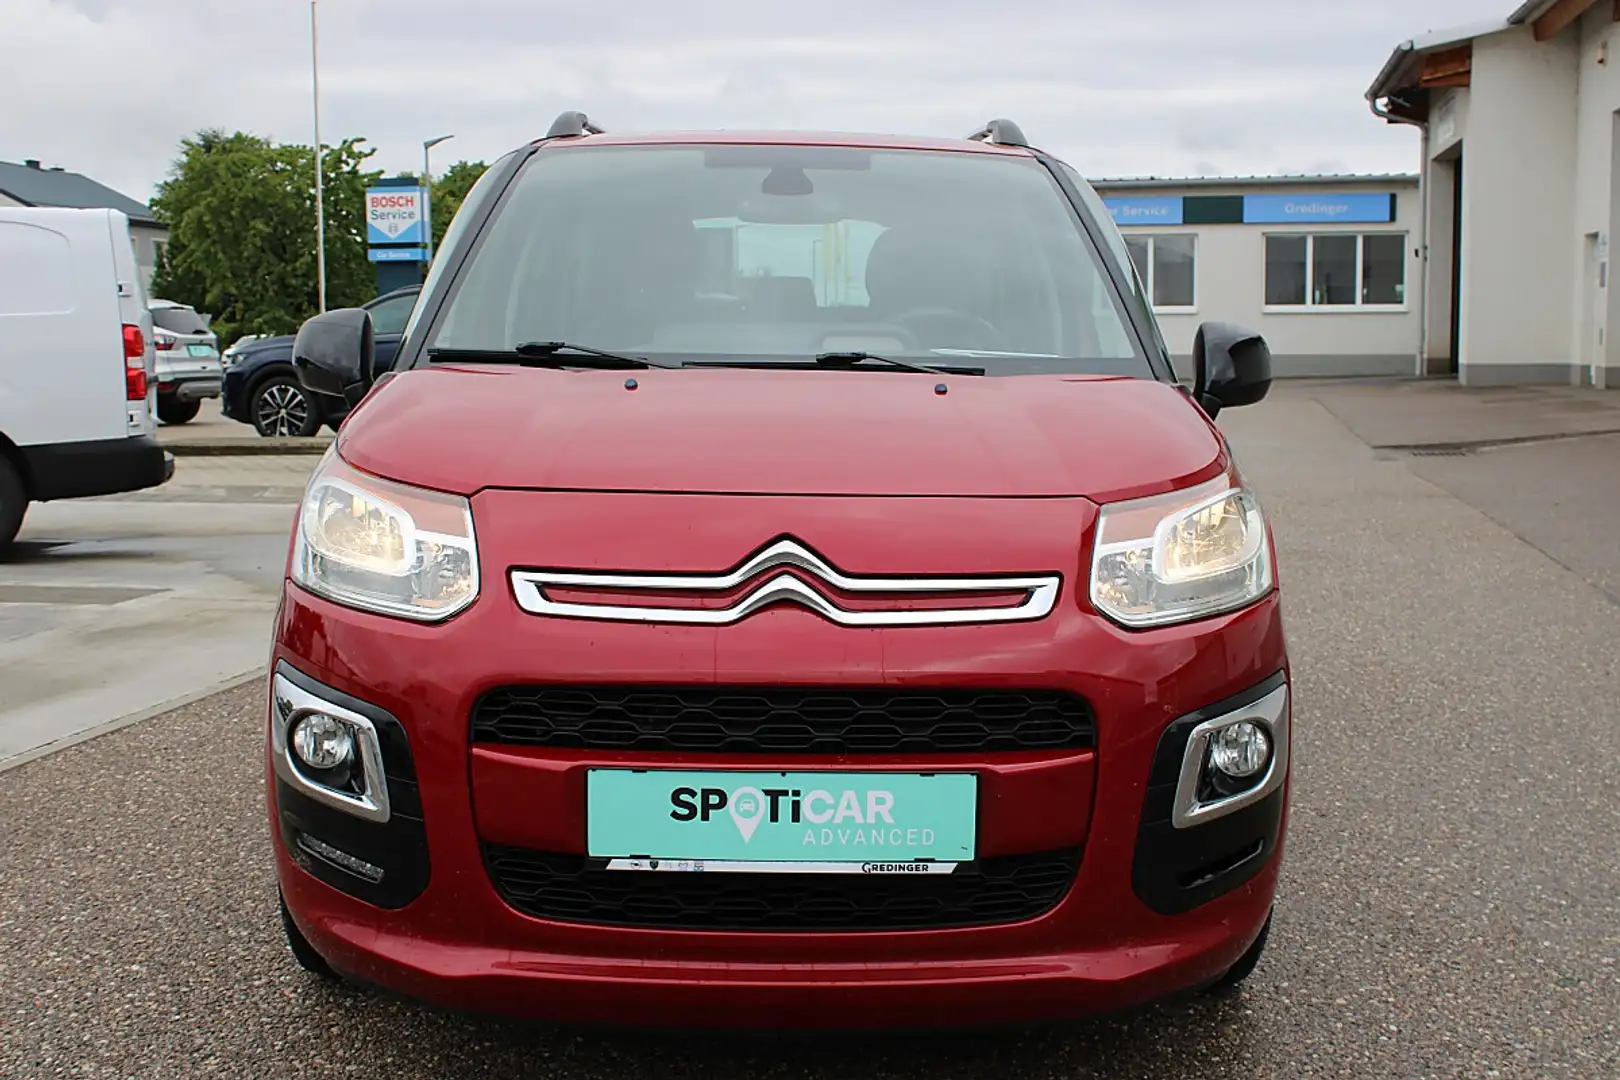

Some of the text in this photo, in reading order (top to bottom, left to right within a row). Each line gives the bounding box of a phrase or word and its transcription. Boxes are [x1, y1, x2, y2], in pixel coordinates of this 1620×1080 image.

[371, 196, 414, 207] BOSCH
[371, 209, 415, 220] Service
[1123, 205, 1169, 216] Service
[1285, 202, 1349, 217] Gredinger
[803, 829, 935, 845] ADVANCED
[861, 862, 929, 874] GREDINGER
